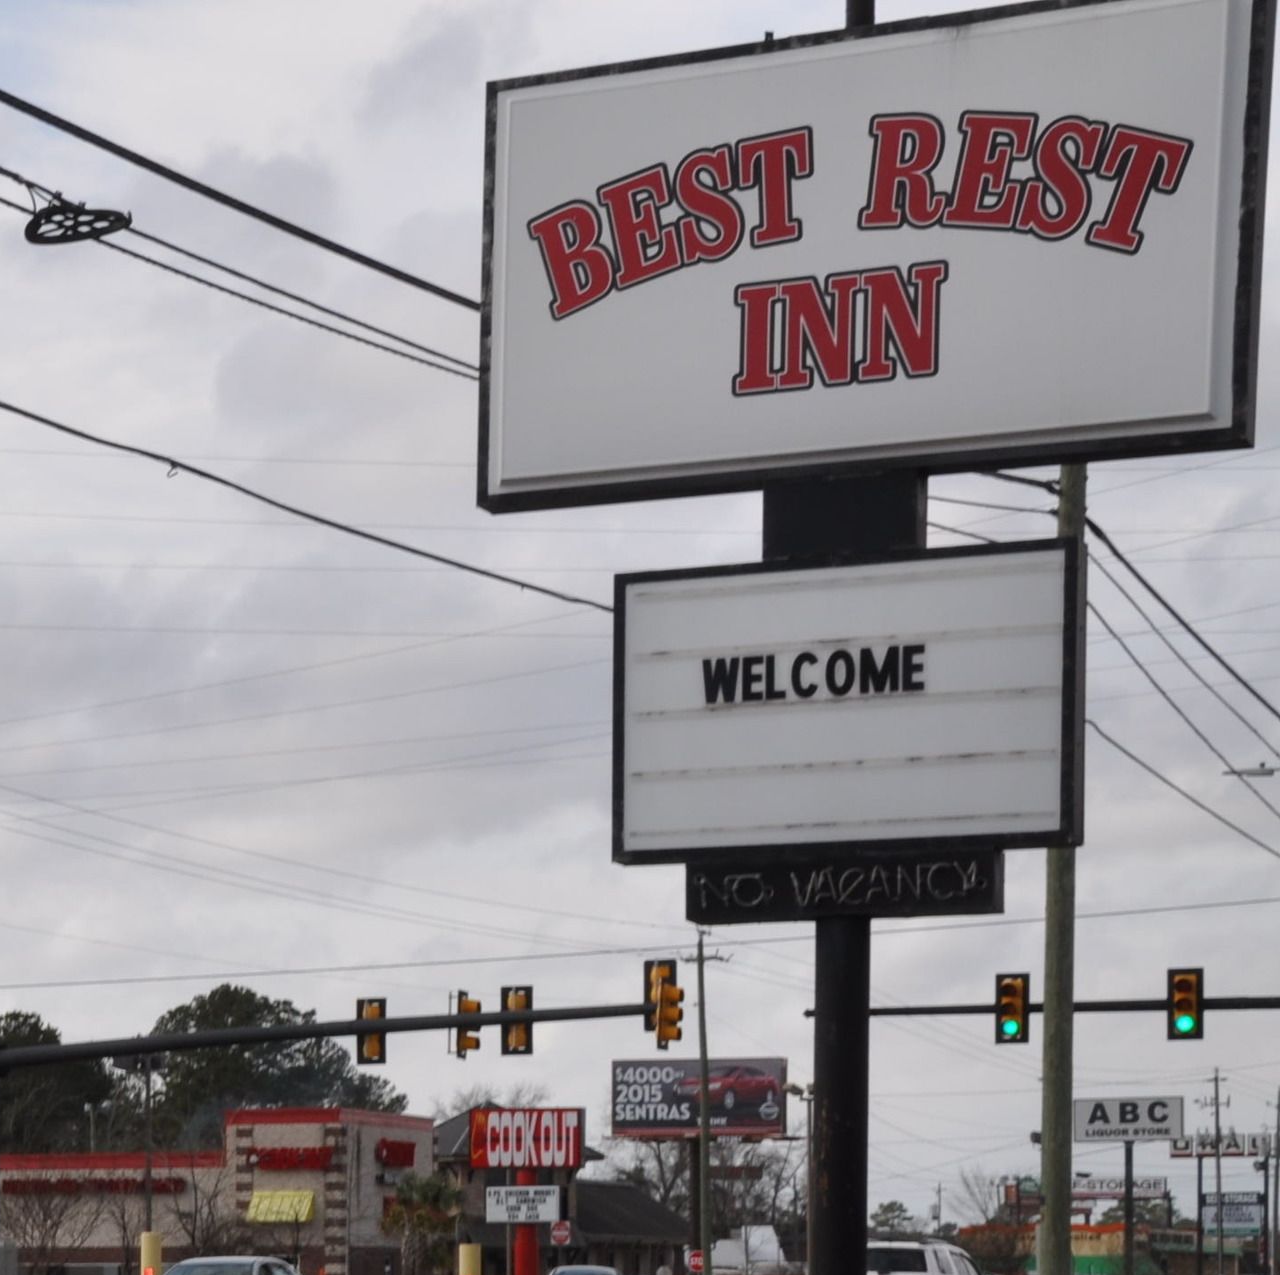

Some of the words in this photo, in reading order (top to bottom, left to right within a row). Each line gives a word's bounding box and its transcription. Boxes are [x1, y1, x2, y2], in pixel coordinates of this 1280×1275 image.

[527, 125, 813, 321] BEST
[857, 110, 1194, 255] REST
[732, 260, 949, 397] INN
[702, 644, 925, 705] WELCOME
[694, 872, 767, 909] NO
[790, 861, 980, 906] VACANCY
[615, 1066, 674, 1085] $4000
[616, 1083, 663, 1104] 2015
[615, 1102, 690, 1121] SENTRAS
[1085, 1128, 1129, 1138] LIQUOR
[1133, 1127, 1171, 1137] STORE
[690, 1256, 704, 1265] STO
